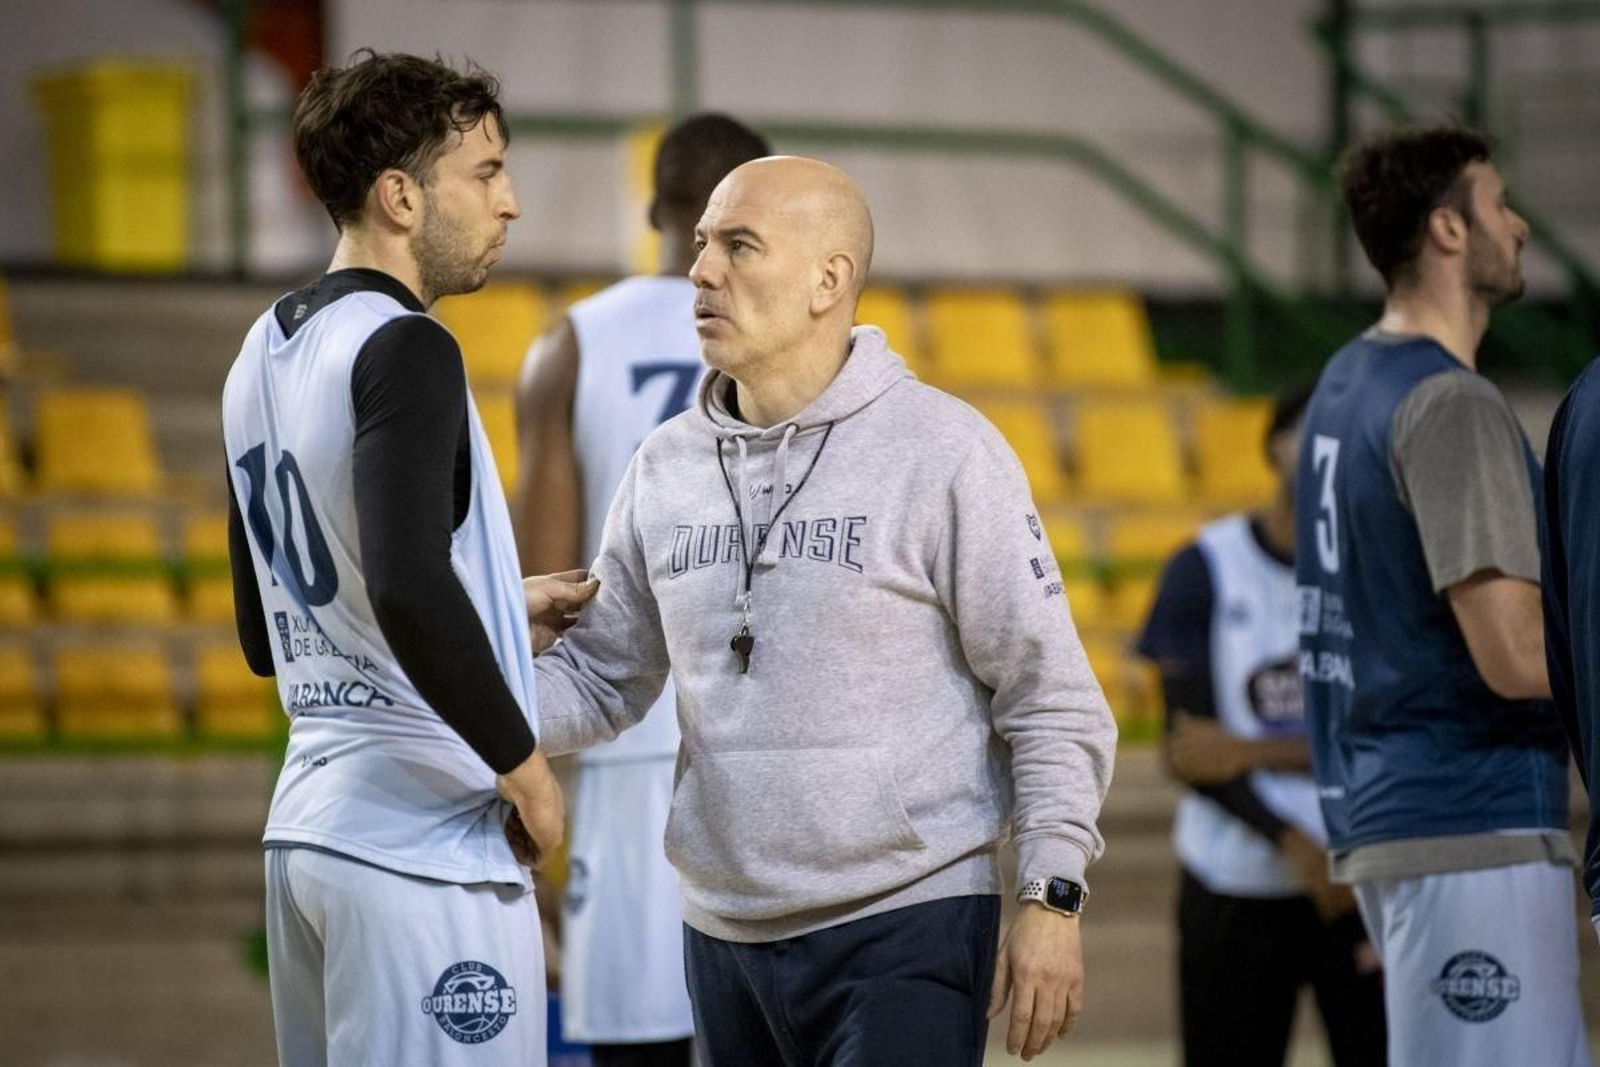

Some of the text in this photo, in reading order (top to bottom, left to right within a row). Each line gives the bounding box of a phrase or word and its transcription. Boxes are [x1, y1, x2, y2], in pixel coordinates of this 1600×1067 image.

[630, 361, 701, 425] 7
[234, 441, 339, 608] 10
[1312, 434, 1341, 574] 3
[293, 637, 312, 658] DE
[451, 962, 483, 975] CLUB
[421, 985, 517, 1016] OURENSE
